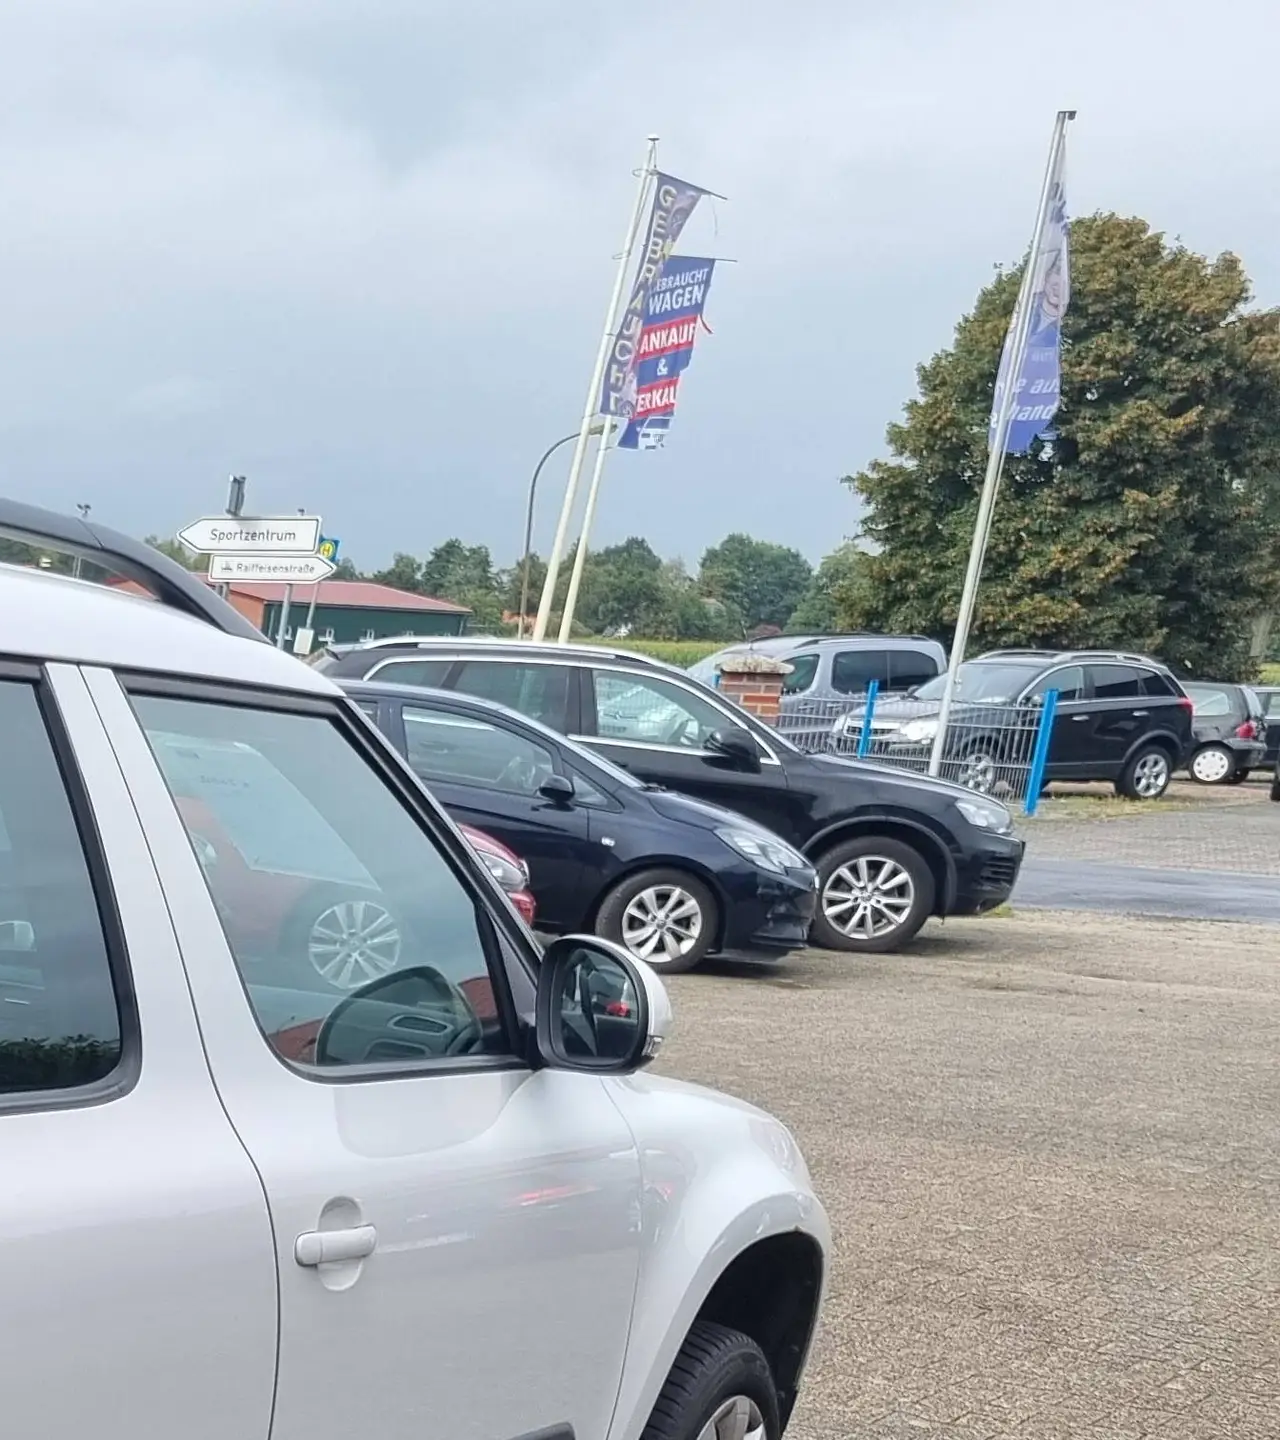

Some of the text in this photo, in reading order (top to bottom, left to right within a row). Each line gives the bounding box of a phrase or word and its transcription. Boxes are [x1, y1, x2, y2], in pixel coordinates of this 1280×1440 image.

[648, 284, 705, 316] WAGEN
[657, 358, 669, 376] &
[210, 528, 296, 543] Sportzentrum
[236, 563, 316, 574] Raiffeisenstraße
